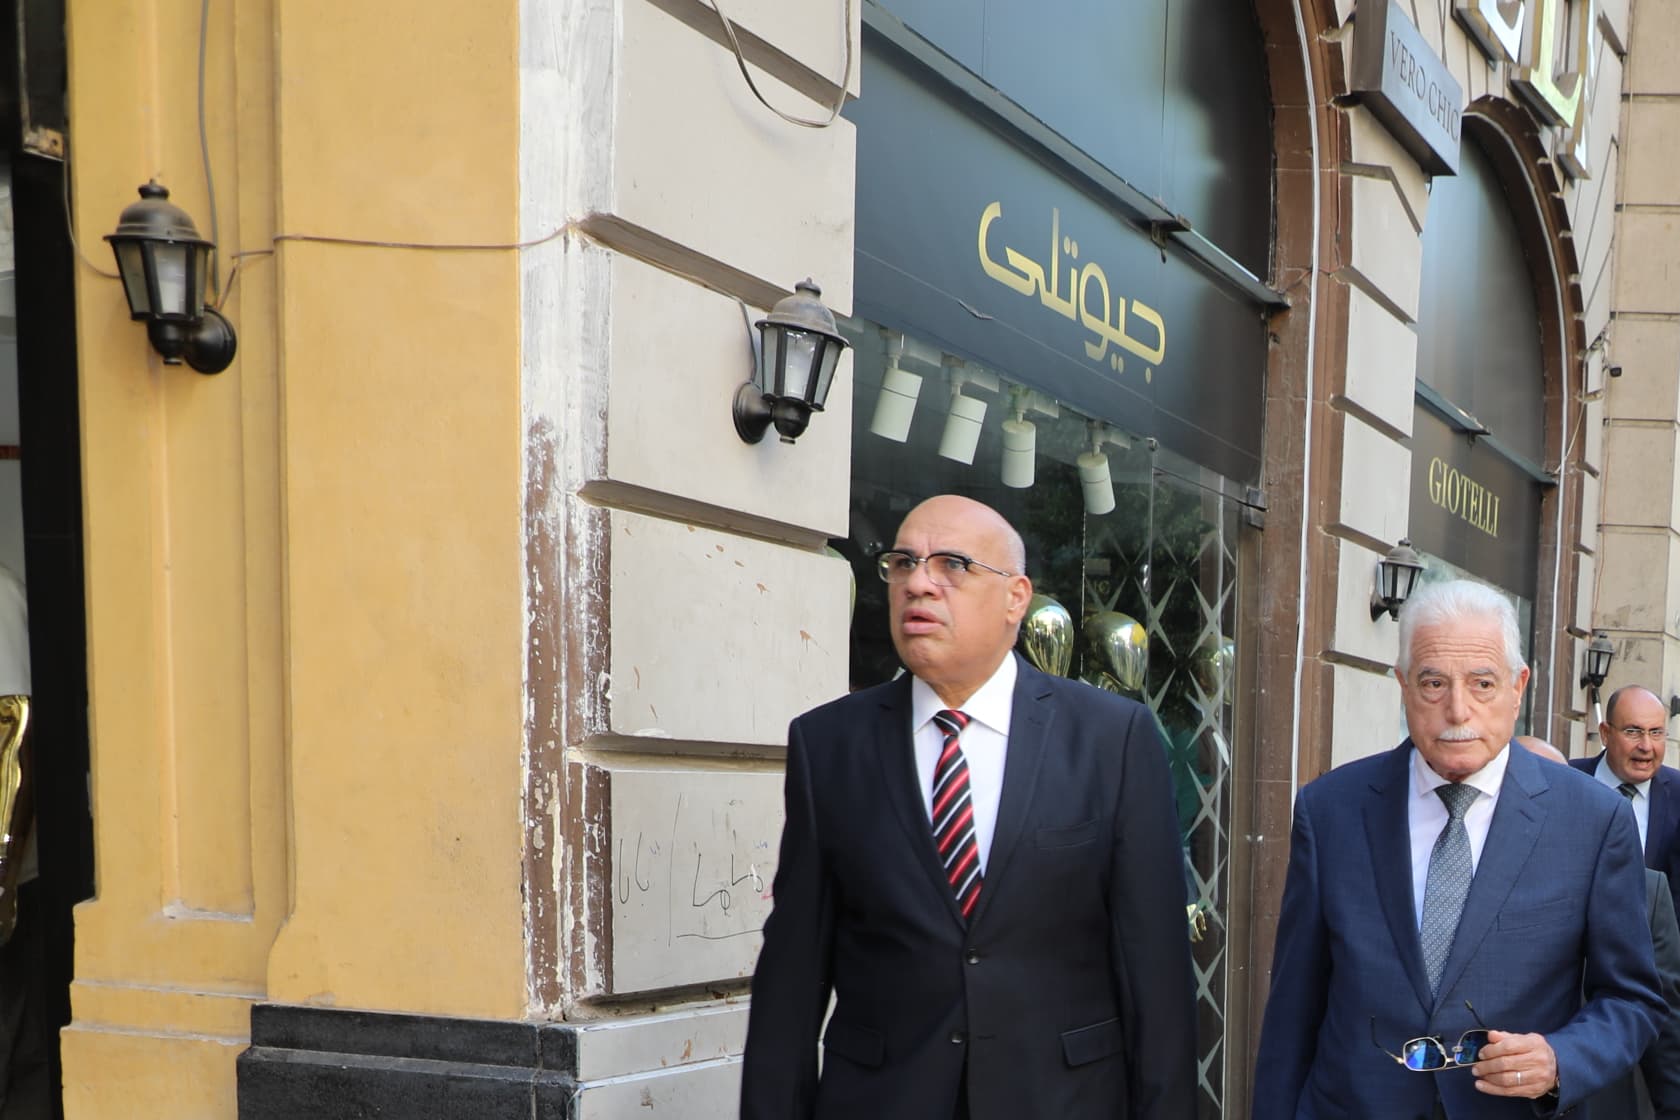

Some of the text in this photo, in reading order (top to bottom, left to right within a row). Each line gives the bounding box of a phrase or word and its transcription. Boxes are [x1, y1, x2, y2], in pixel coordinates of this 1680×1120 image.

[1390, 30, 1460, 142] VERO CHIC
[1429, 456, 1500, 538] GIOTELLI
